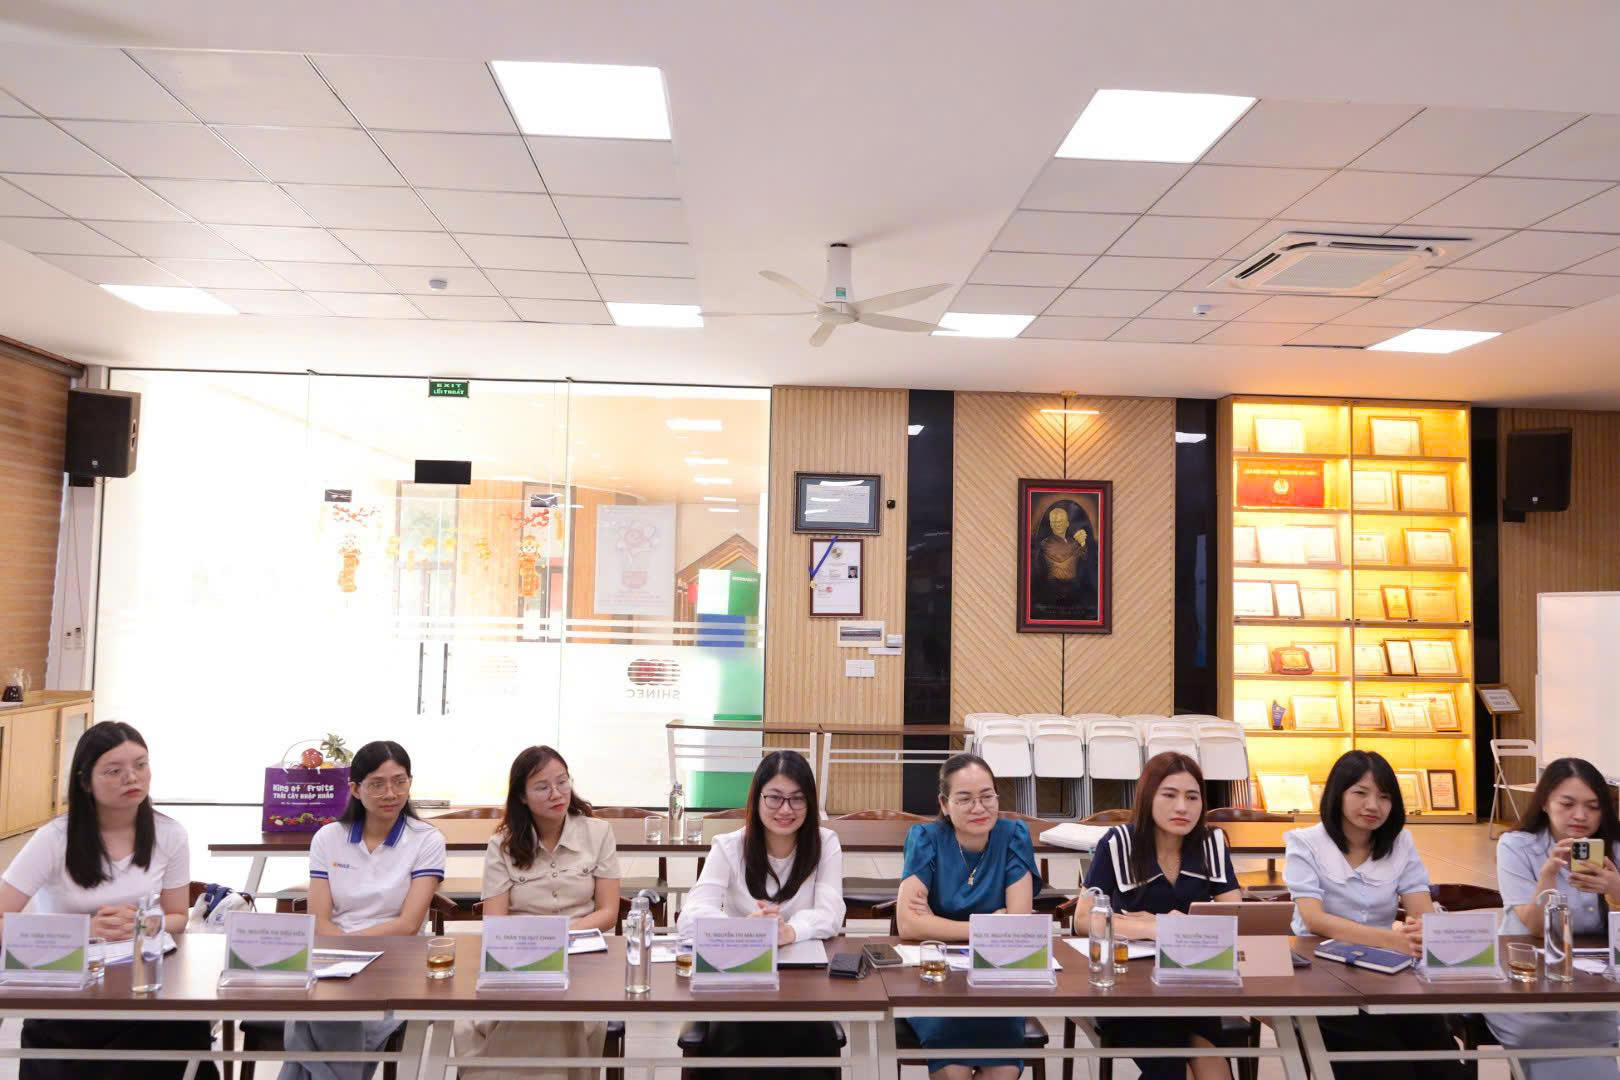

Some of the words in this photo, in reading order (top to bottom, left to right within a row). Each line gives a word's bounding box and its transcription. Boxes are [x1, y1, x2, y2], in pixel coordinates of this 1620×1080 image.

[272, 784, 289, 792] King
[290, 784, 301, 792] of
[306, 784, 335, 792] Fruits
[273, 791, 287, 799] TRÁI
[287, 791, 299, 799] CÂY
